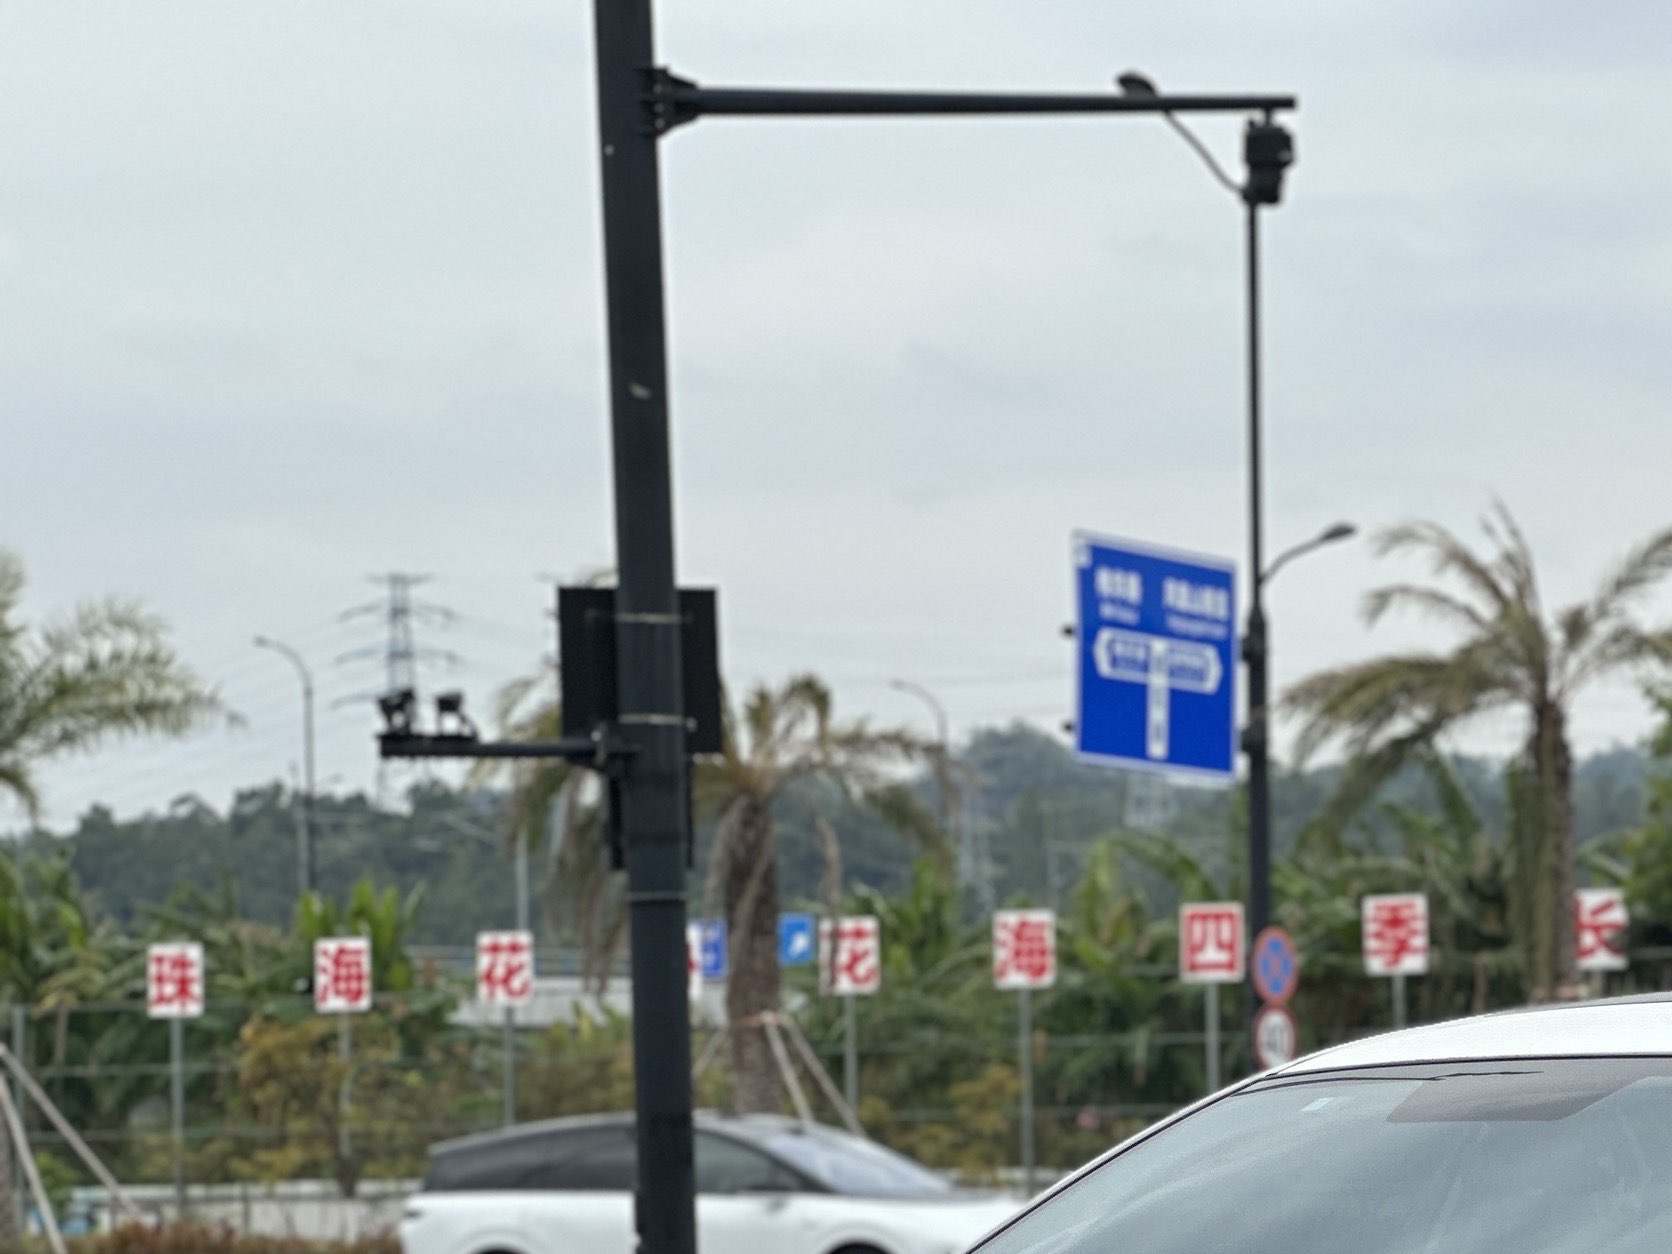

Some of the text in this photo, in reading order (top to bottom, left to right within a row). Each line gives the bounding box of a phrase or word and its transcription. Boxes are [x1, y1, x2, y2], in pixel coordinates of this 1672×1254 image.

[995, 918, 1054, 980] 海
[1183, 909, 1239, 972] 四
[1367, 901, 1422, 967] 季
[150, 953, 197, 1008] 珠
[317, 944, 368, 1004] 海
[477, 938, 529, 1000] 花
